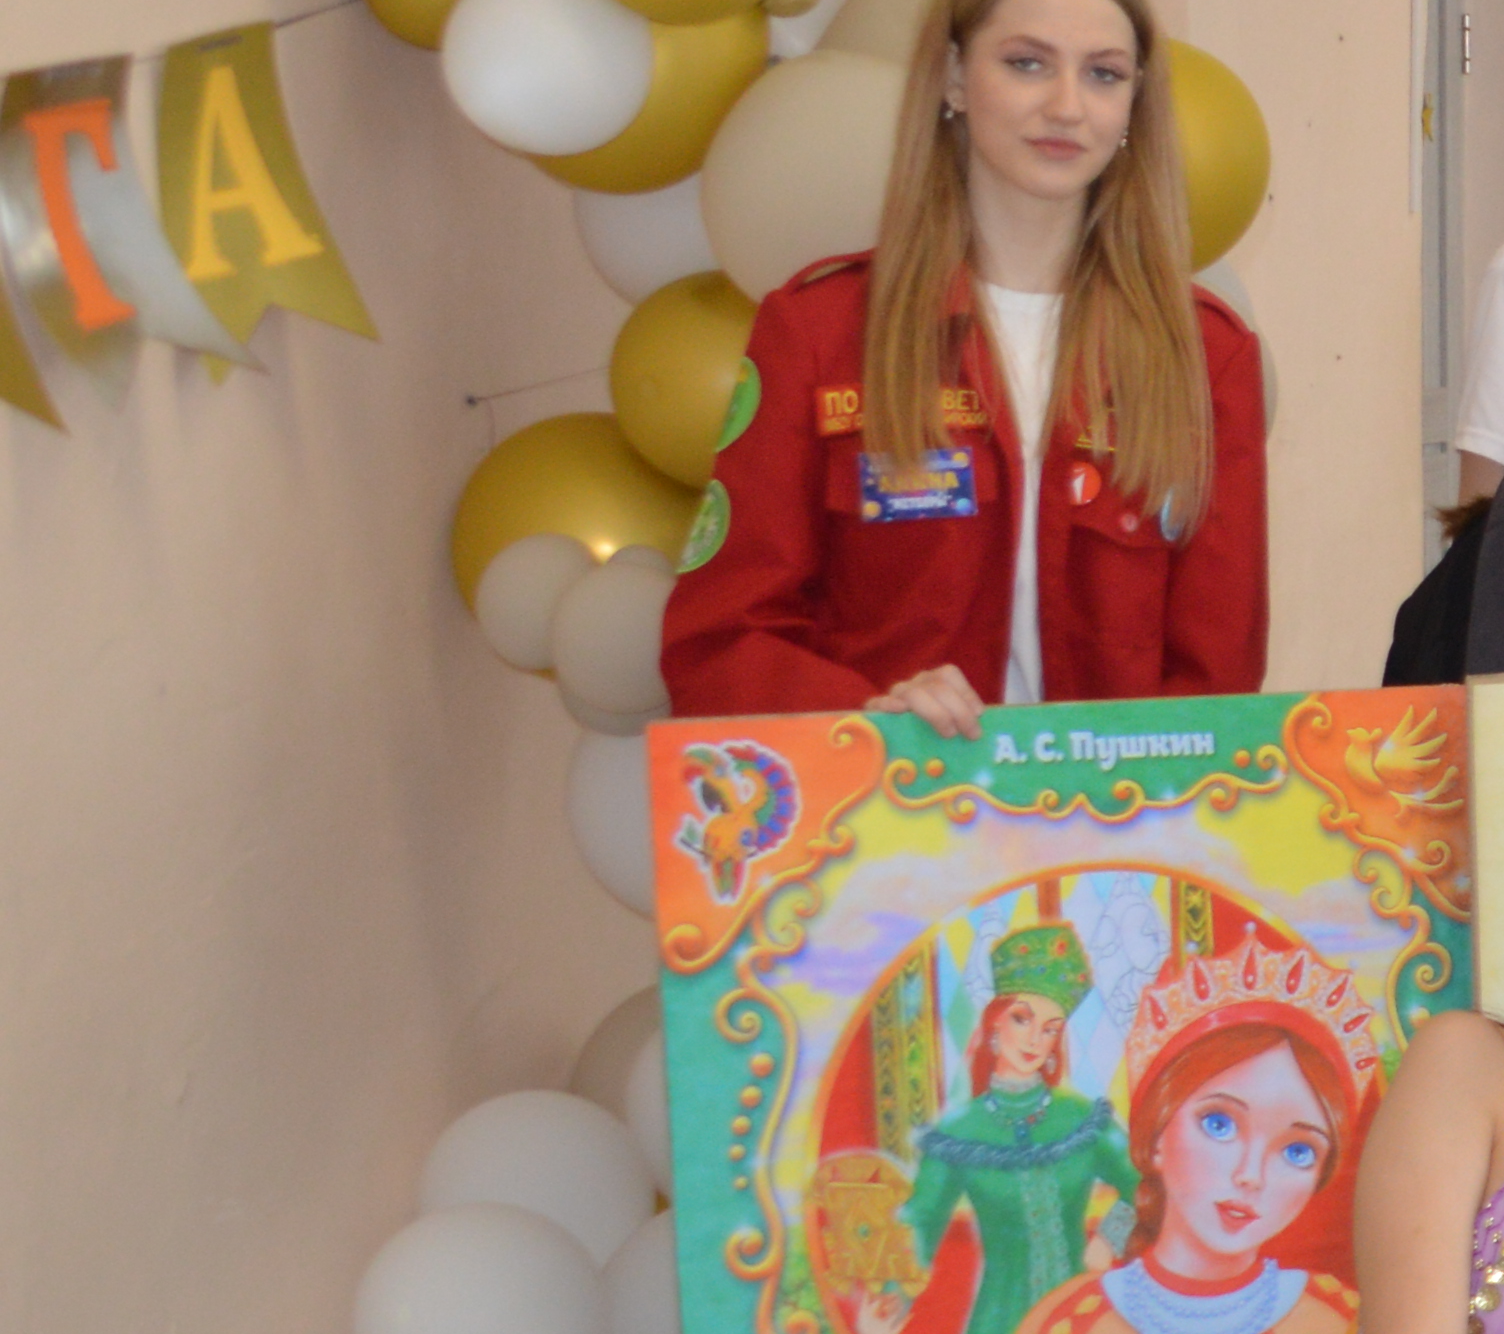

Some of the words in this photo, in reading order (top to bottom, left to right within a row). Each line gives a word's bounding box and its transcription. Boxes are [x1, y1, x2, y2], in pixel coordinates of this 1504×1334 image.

[825, 391, 859, 416] ПО
[994, 733, 1028, 764] А.
[1034, 731, 1064, 763] С.
[1069, 730, 1215, 771] Пушкин
